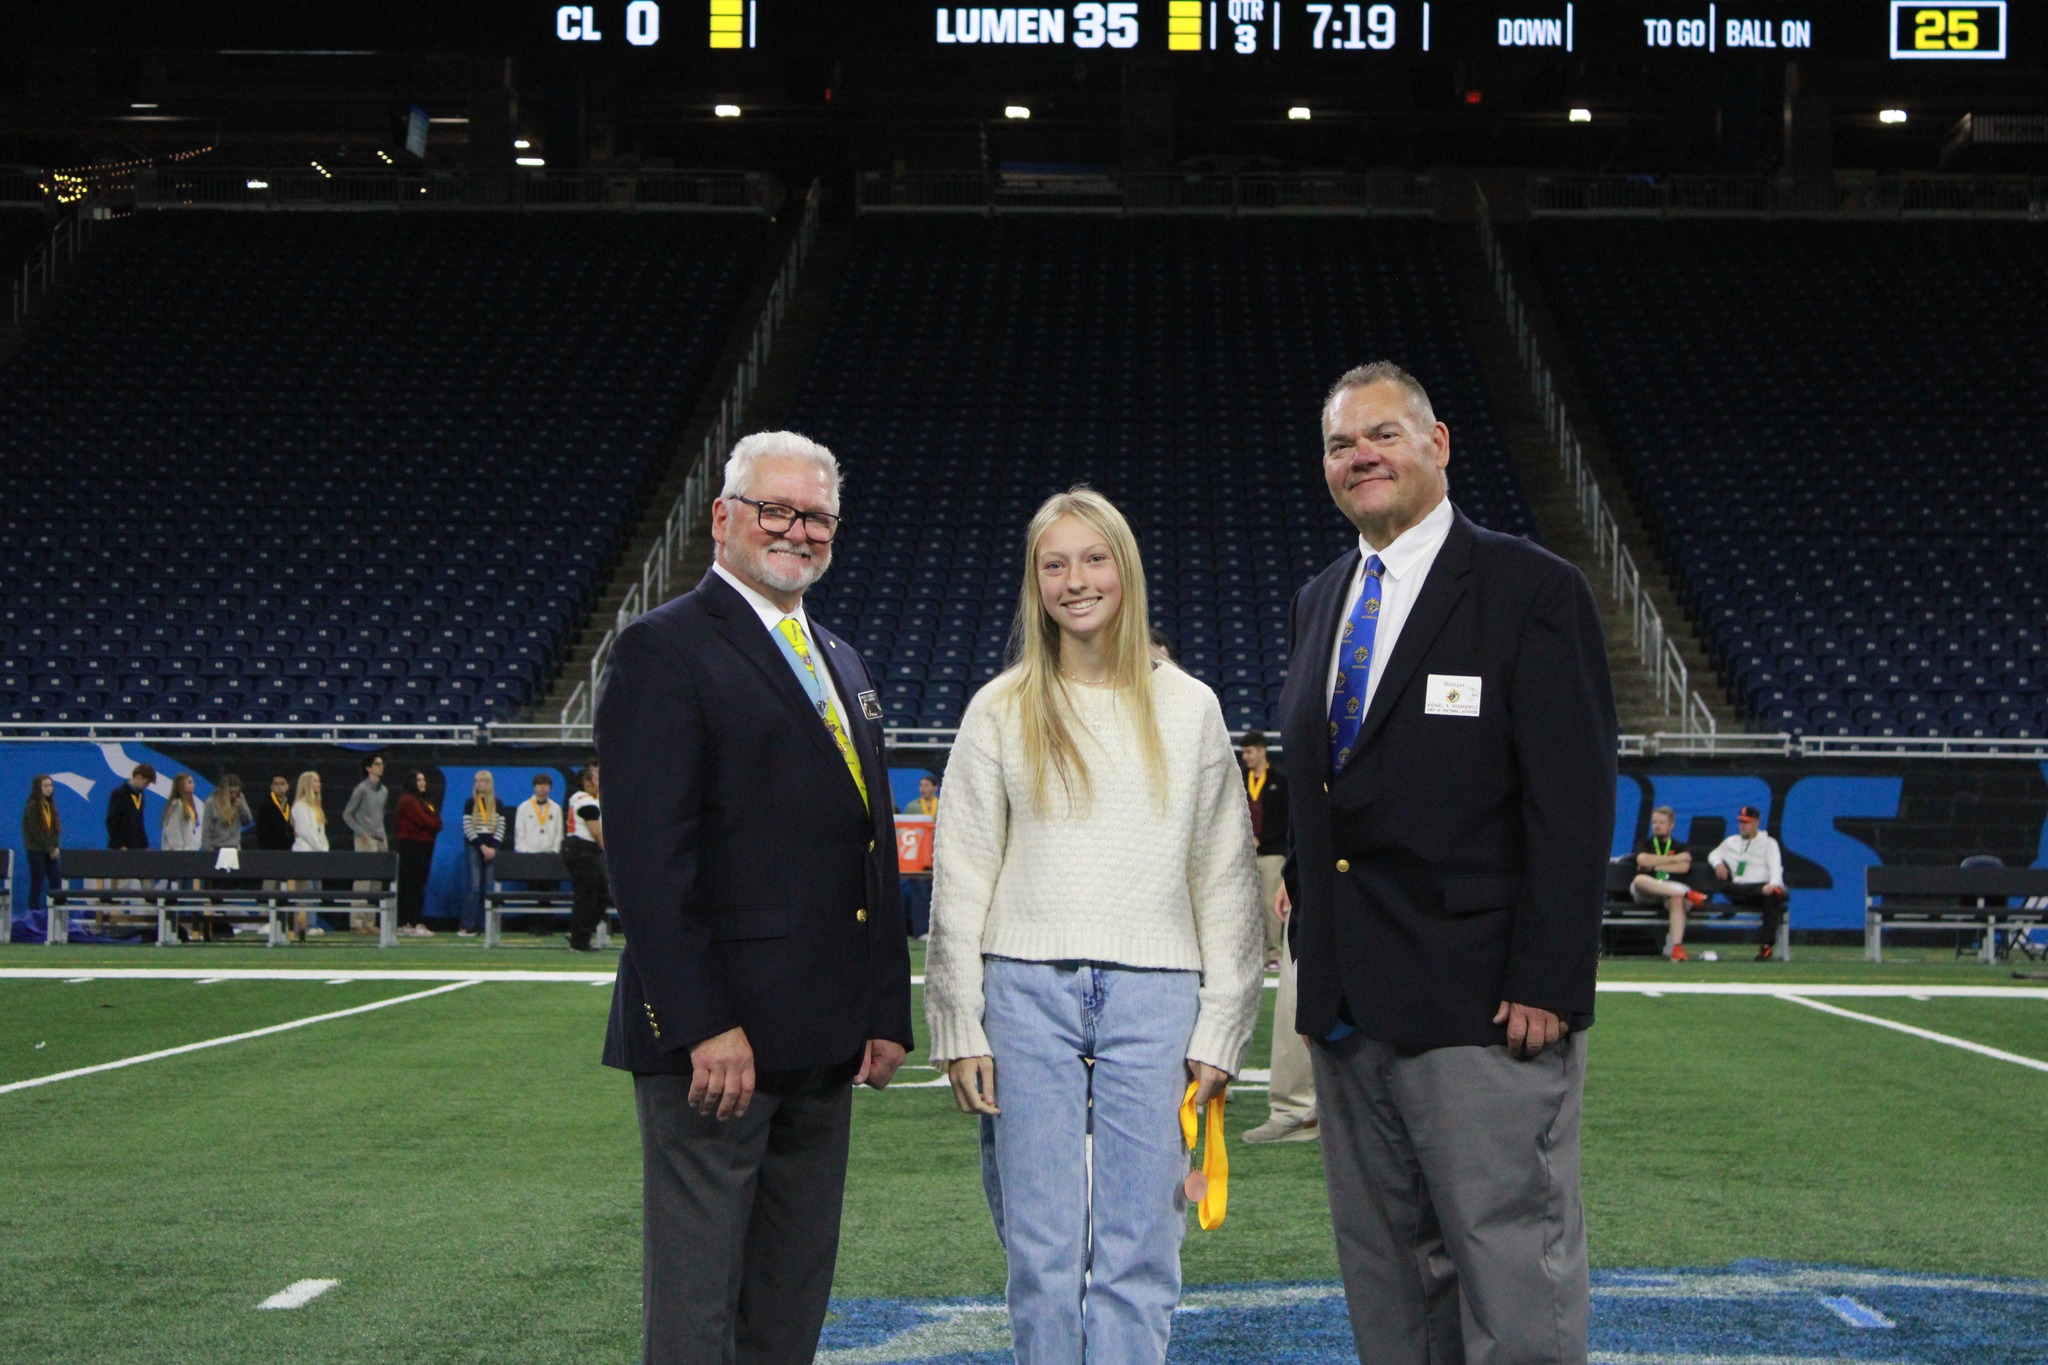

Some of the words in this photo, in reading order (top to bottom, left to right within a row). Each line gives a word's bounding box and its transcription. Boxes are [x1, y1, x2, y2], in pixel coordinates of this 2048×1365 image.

[556, 6, 602, 41] CL
[625, 0, 660, 47] 0
[935, 7, 1065, 44] LUMEN
[1072, 2, 1139, 49] 35
[1228, 0, 1265, 24] QTR
[1305, 3, 1396, 50] 7:19
[1234, 24, 1257, 55] 3
[1497, 18, 1563, 47] DOWN
[1643, 18, 1673, 47] TO
[1676, 18, 1707, 48] GO
[1725, 18, 1777, 49] BALL
[1781, 19, 1812, 49] ON
[1914, 9, 1979, 50] 25
[902, 830, 916, 845] G
